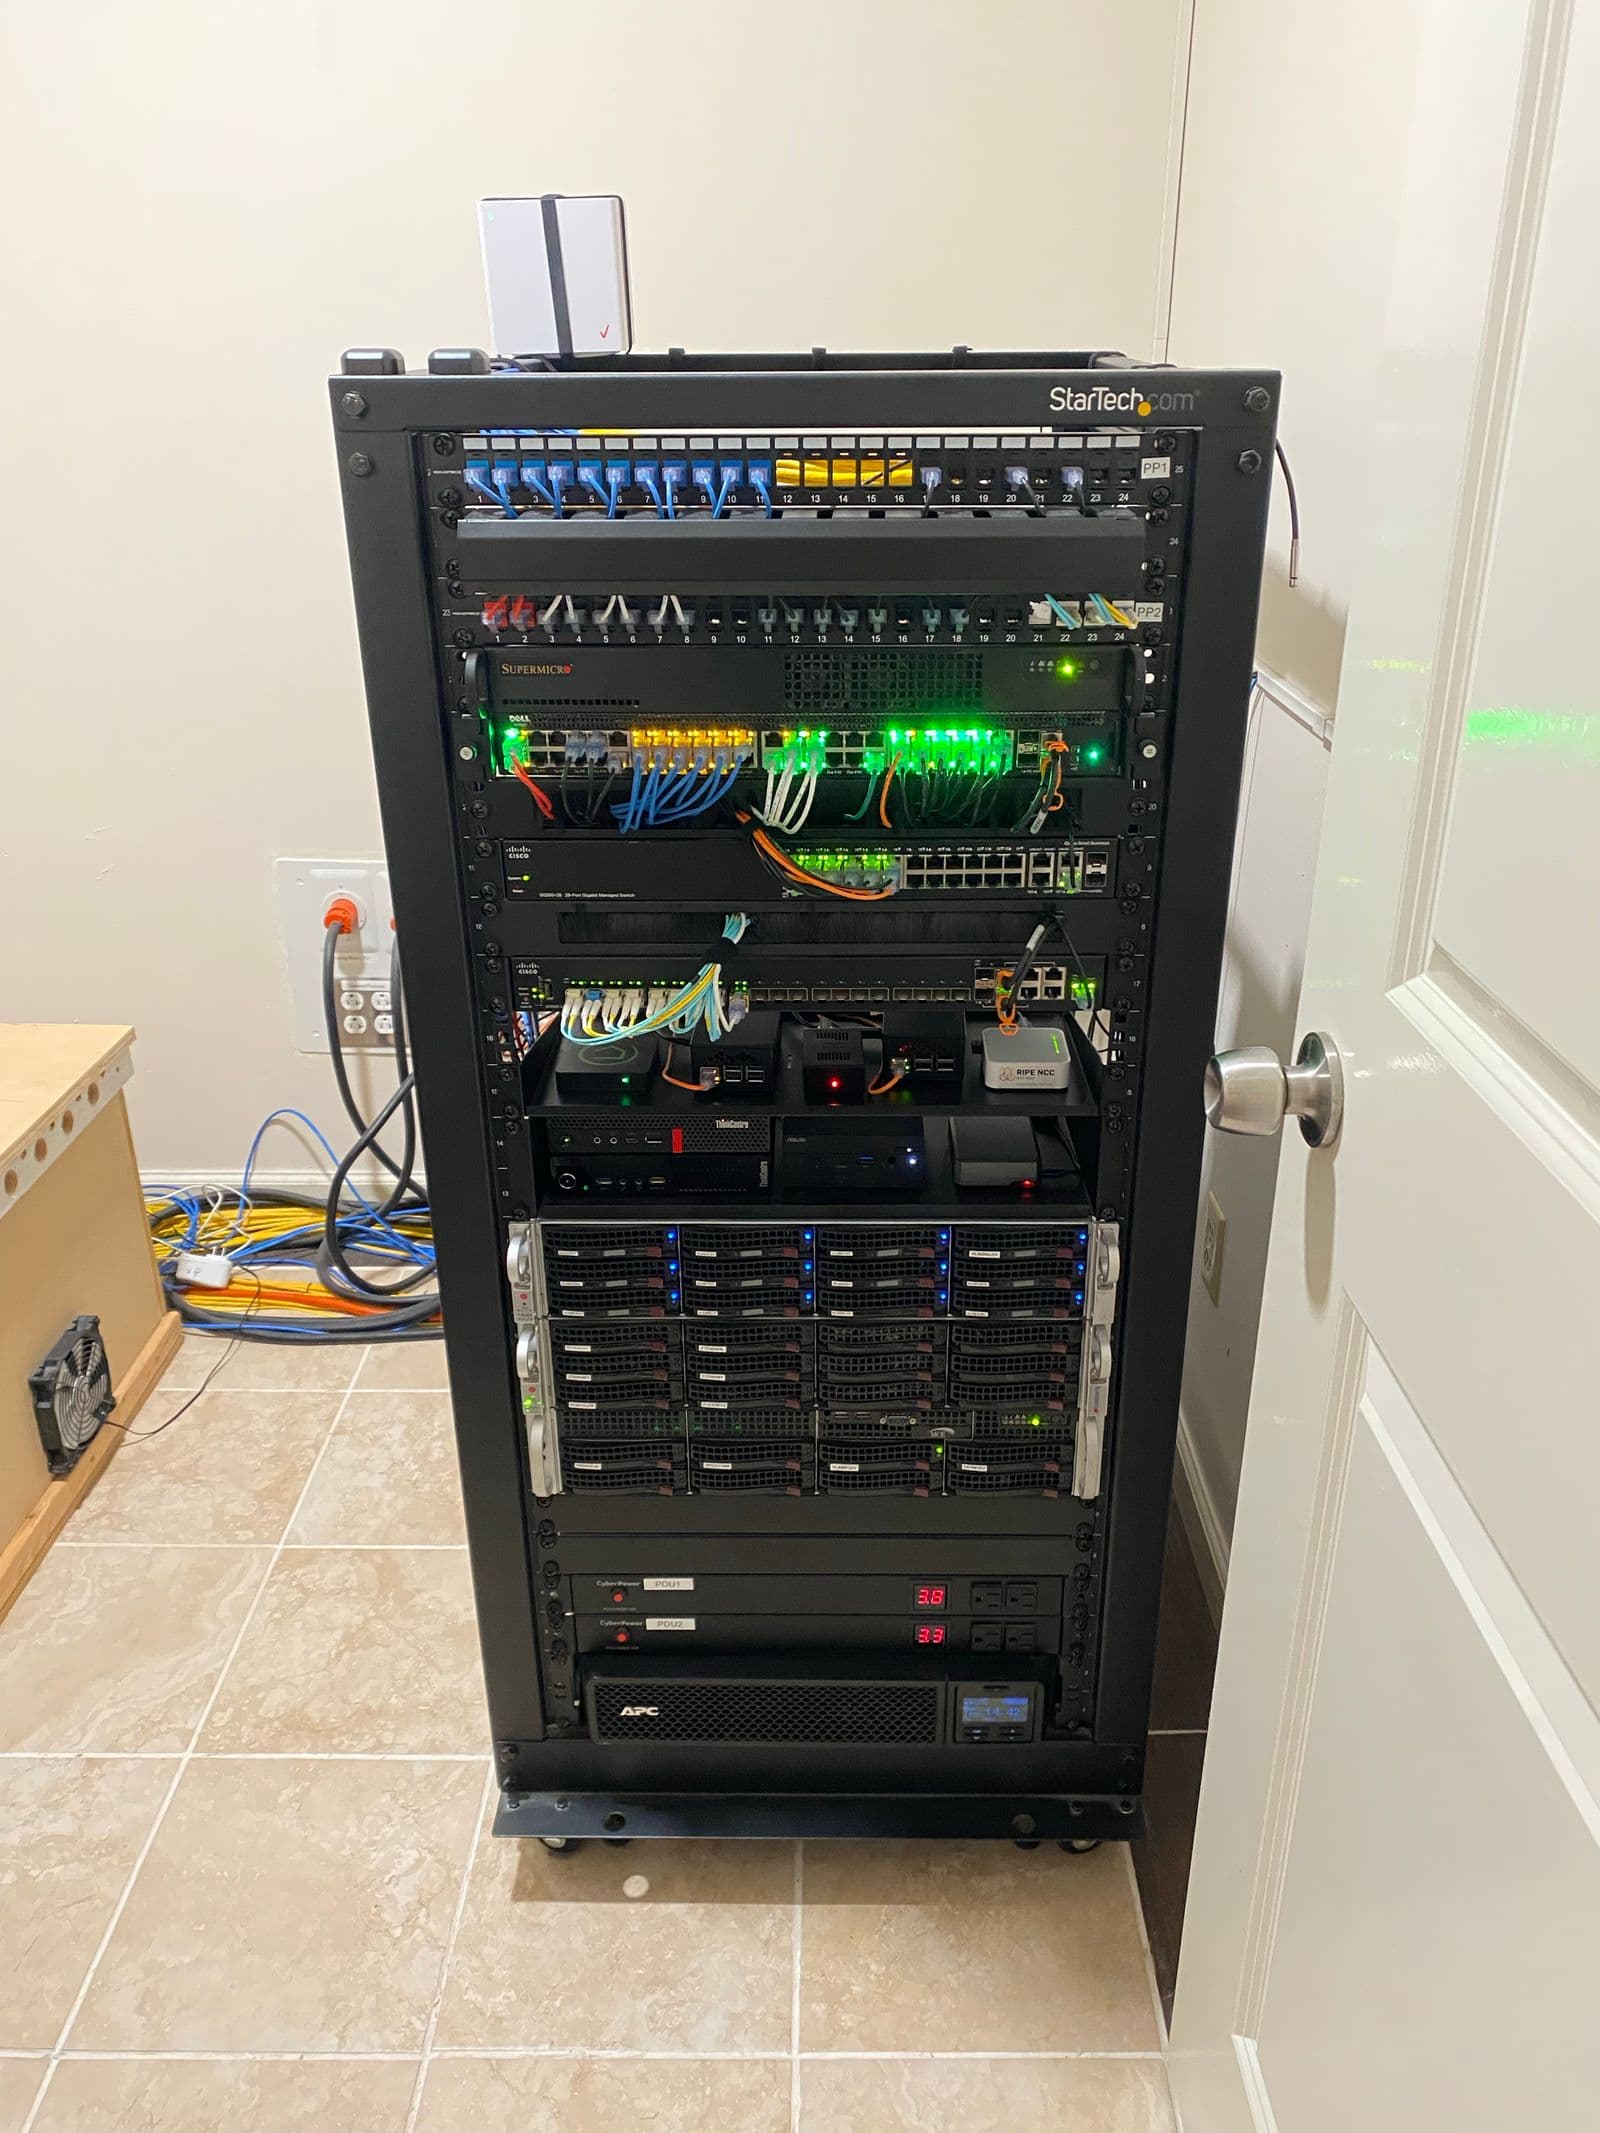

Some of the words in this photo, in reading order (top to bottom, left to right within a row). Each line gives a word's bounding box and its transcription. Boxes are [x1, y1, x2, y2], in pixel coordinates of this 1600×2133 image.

[1049, 386, 1194, 417] StarTech.com
[1143, 462, 1167, 475] PP1
[477, 495, 482, 503] 1
[532, 495, 538, 503] 3
[588, 495, 595, 503] 5
[617, 495, 623, 504] 6
[645, 495, 650, 503] 7
[672, 495, 679, 503] 8
[700, 495, 706, 503] 9
[727, 495, 737, 503] 10
[782, 495, 793, 503] 12
[810, 495, 821, 503] 13
[838, 495, 848, 503] 14
[866, 495, 877, 503] 15
[894, 495, 905, 503] 16
[950, 494, 961, 503] 18
[979, 494, 989, 503] 19
[1006, 494, 1017, 503] 20
[1062, 494, 1073, 503] 22
[1090, 493, 1101, 502] 23
[1118, 492, 1129, 502] 24
[1137, 607, 1162, 618] PP2
[495, 635, 500, 643] 1
[521, 635, 528, 643] 2
[549, 635, 555, 643] 3
[576, 635, 582, 643] 4
[603, 635, 609, 643] 5
[630, 635, 636, 643] 6
[657, 635, 662, 643] 7
[683, 635, 690, 643] 8
[710, 635, 717, 643] 9
[736, 635, 746, 643] 10
[764, 635, 773, 643] 11
[790, 635, 800, 643] 12
[817, 635, 827, 643] 13
[844, 635, 854, 643] 14
[871, 635, 881, 643] 15
[898, 635, 908, 643] 16
[925, 634, 935, 643] 17
[952, 634, 962, 643] 18
[979, 634, 989, 643] 19
[1005, 634, 1016, 642] 20
[1033, 634, 1043, 642] 21
[1060, 633, 1070, 642] 22
[1087, 633, 1097, 642] 23
[1114, 632, 1125, 641] 24
[1016, 1068, 1036, 1077] RIPE
[1037, 1068, 1056, 1076] NCC
[655, 1580, 681, 1588] PDU1
[657, 1620, 684, 1628] PDU2
[620, 1706, 659, 1717] APC
